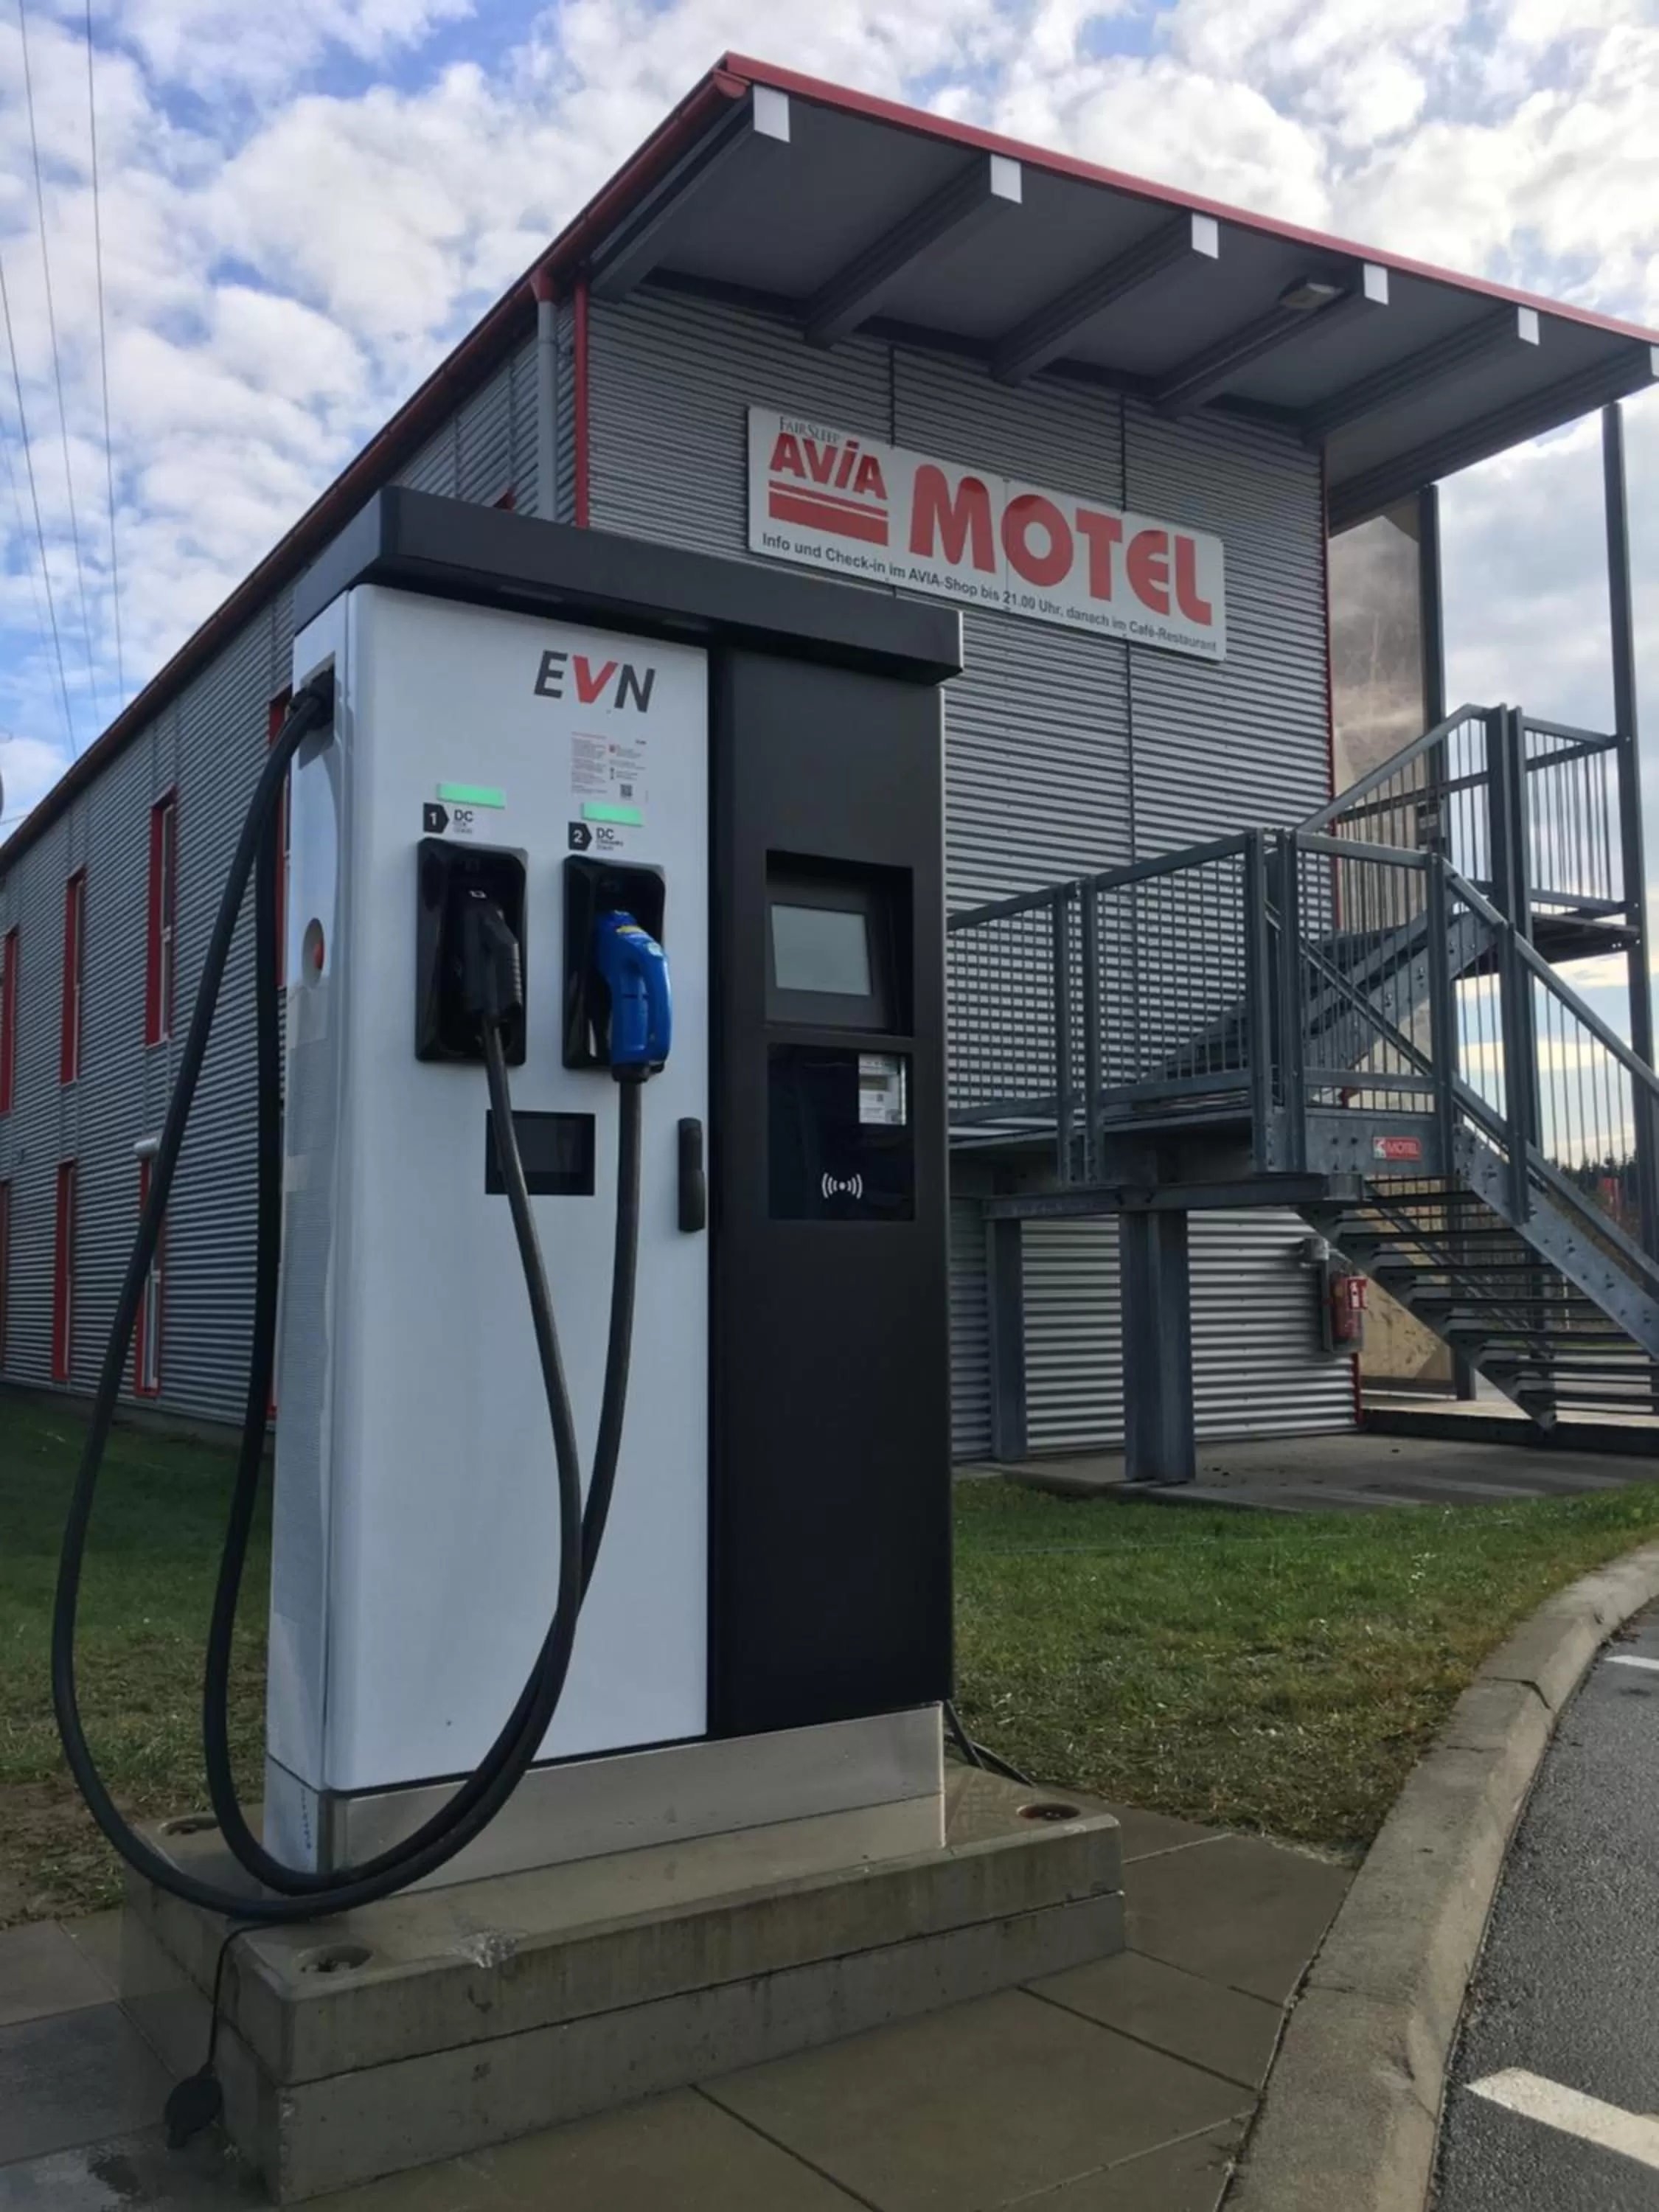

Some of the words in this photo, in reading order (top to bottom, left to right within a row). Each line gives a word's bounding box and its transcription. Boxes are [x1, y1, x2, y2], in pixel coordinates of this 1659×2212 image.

[908, 463, 1211, 626] MOTEL
[762, 533, 790, 551] Info
[794, 543, 821, 559] und
[826, 548, 886, 573] Check-in
[889, 563, 906, 577] im
[908, 568, 977, 597] AVIA-Shop
[981, 584, 1000, 601] bis
[1003, 591, 1036, 610] 21.00
[1066, 607, 1110, 627] danach
[1112, 616, 1127, 630] im
[534, 649, 655, 713] EVN
[429, 811, 437, 826] 1
[454, 809, 473, 822] DC
[573, 829, 583, 844] 2
[596, 827, 614, 840] DC
